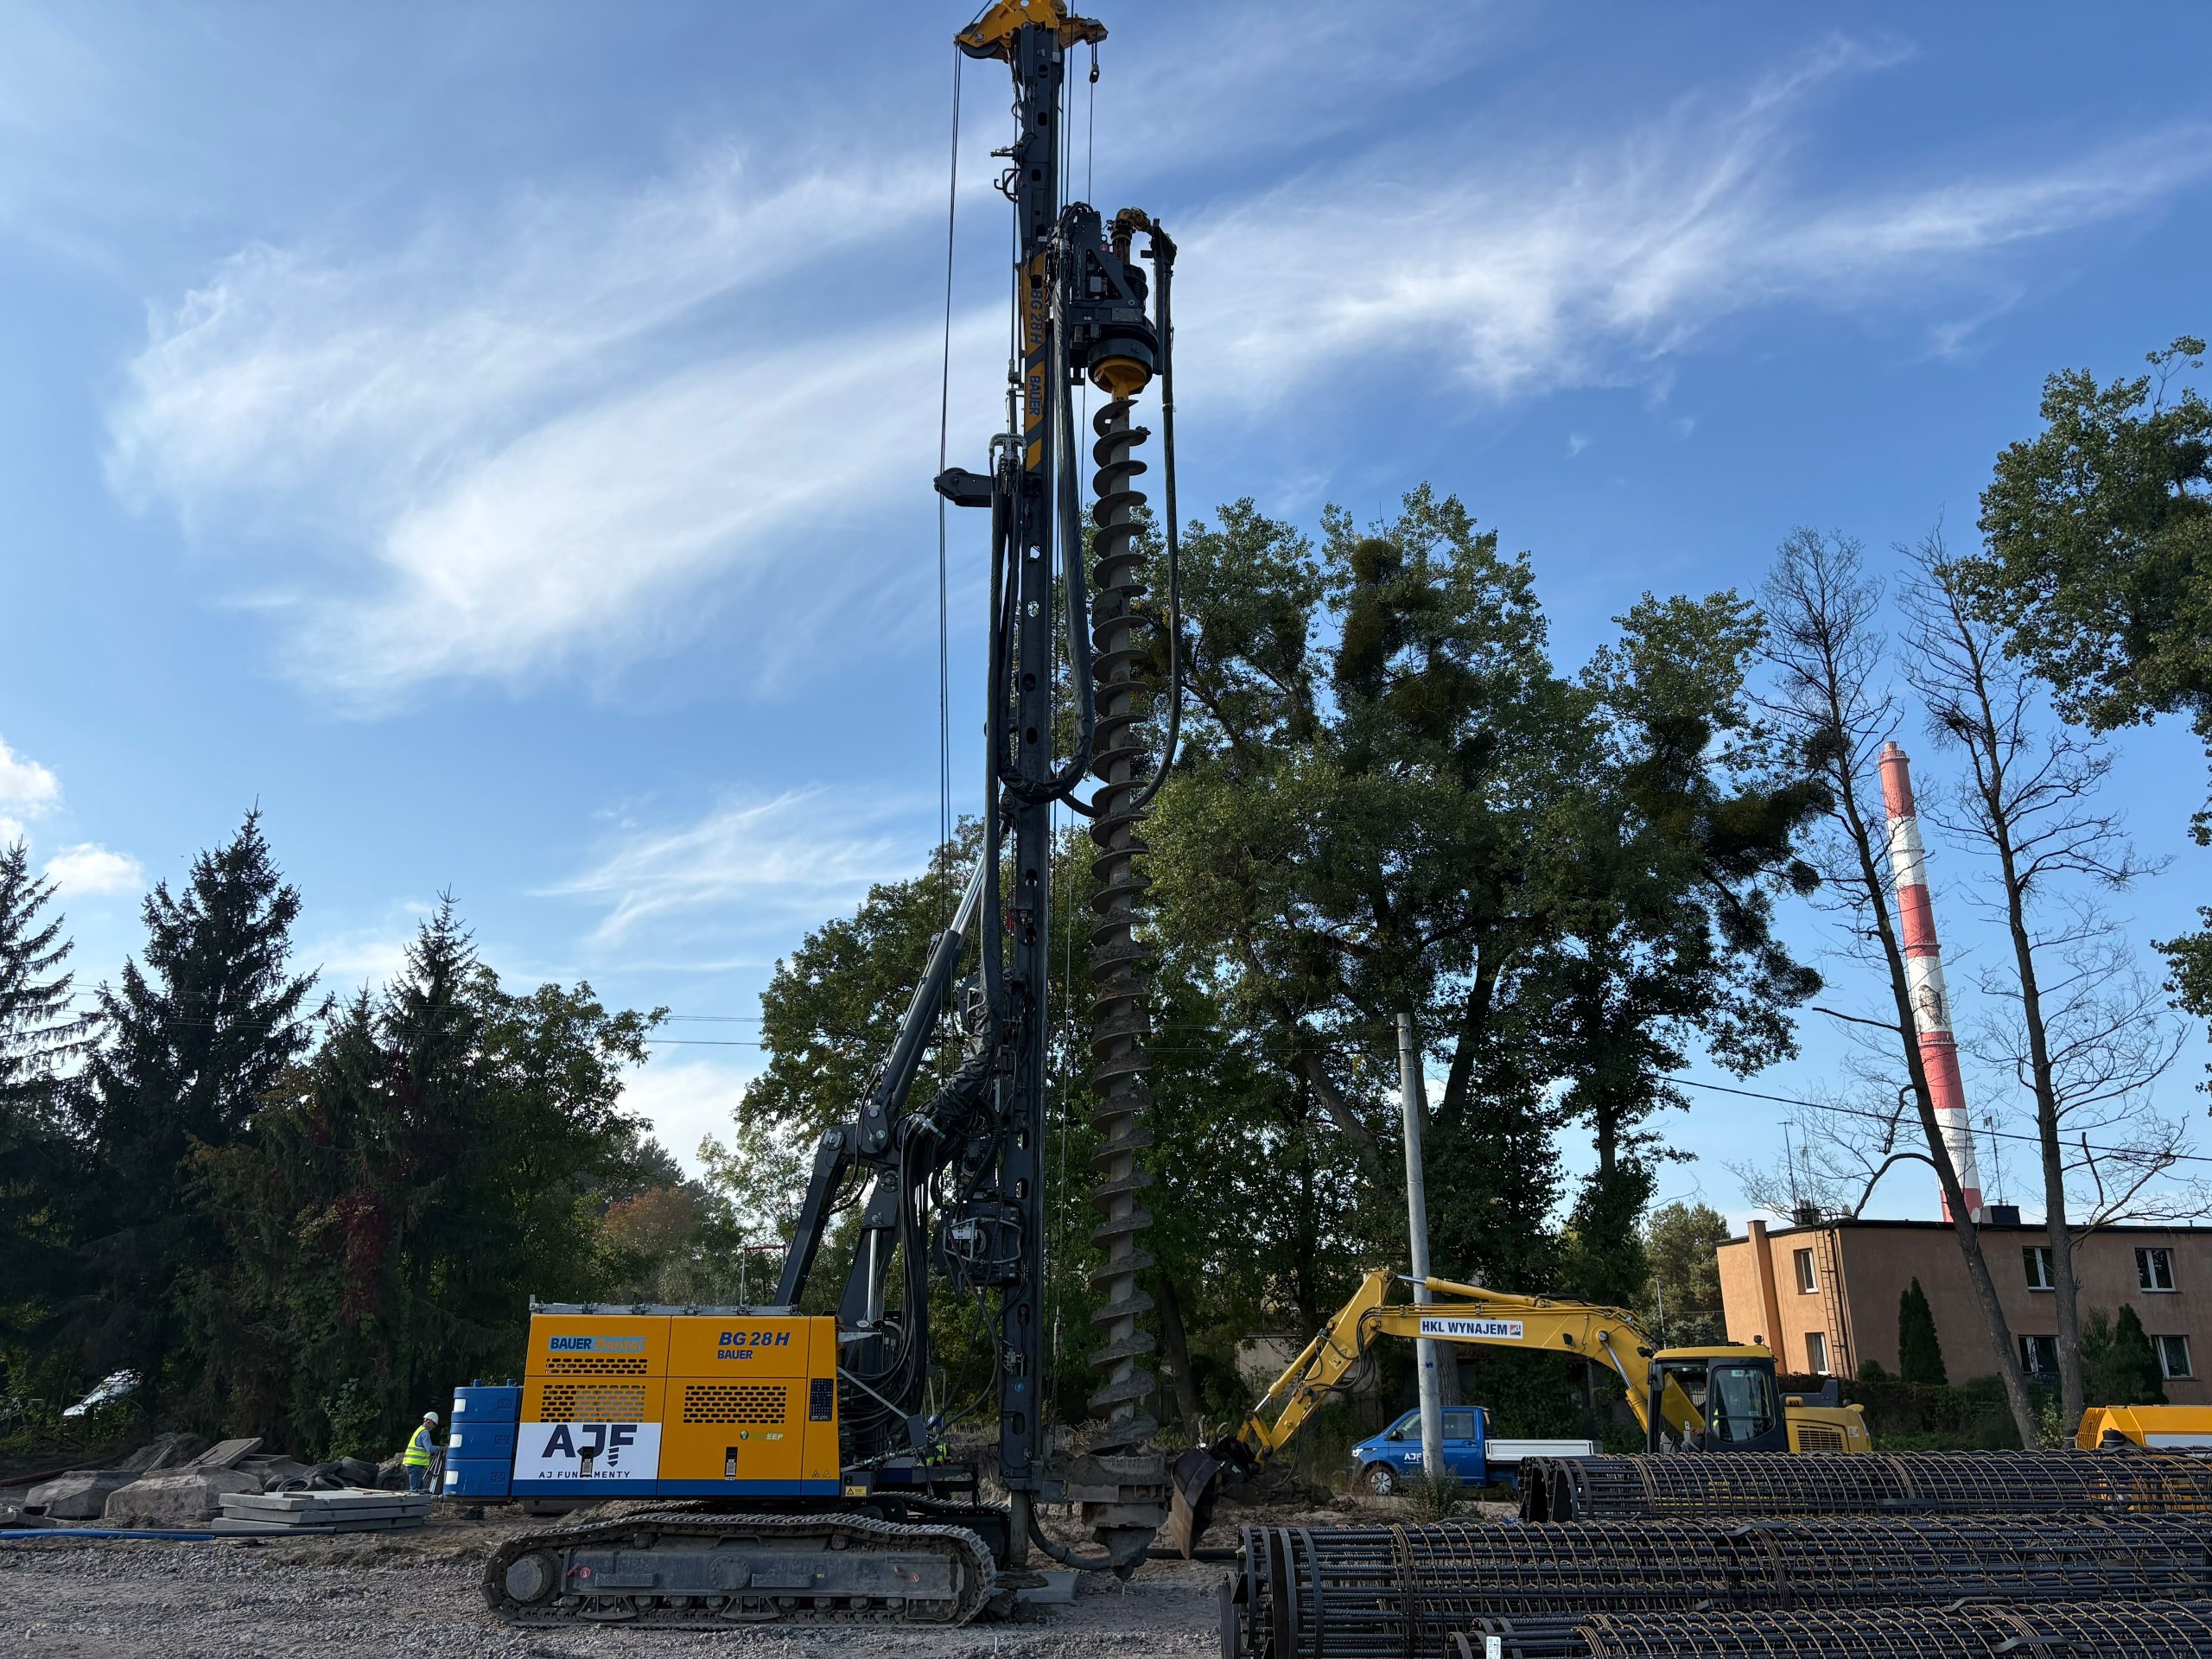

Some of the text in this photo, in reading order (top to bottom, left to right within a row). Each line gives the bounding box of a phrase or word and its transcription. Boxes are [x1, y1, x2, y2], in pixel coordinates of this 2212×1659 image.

[1031, 289, 1043, 310] BG
[1031, 313, 1043, 330] 28
[1029, 376, 1041, 416] BAUER
[1422, 1320, 1507, 1335] HKL WYNAJEM
[550, 1338, 644, 1350] BAUER Rental
[719, 1332, 790, 1346] BG 28 H
[717, 1350, 753, 1359] BAUER
[542, 1424, 638, 1467] AJF
[1404, 1452, 1422, 1462] AJF
[557, 1471, 631, 1479] FUNMENTY
